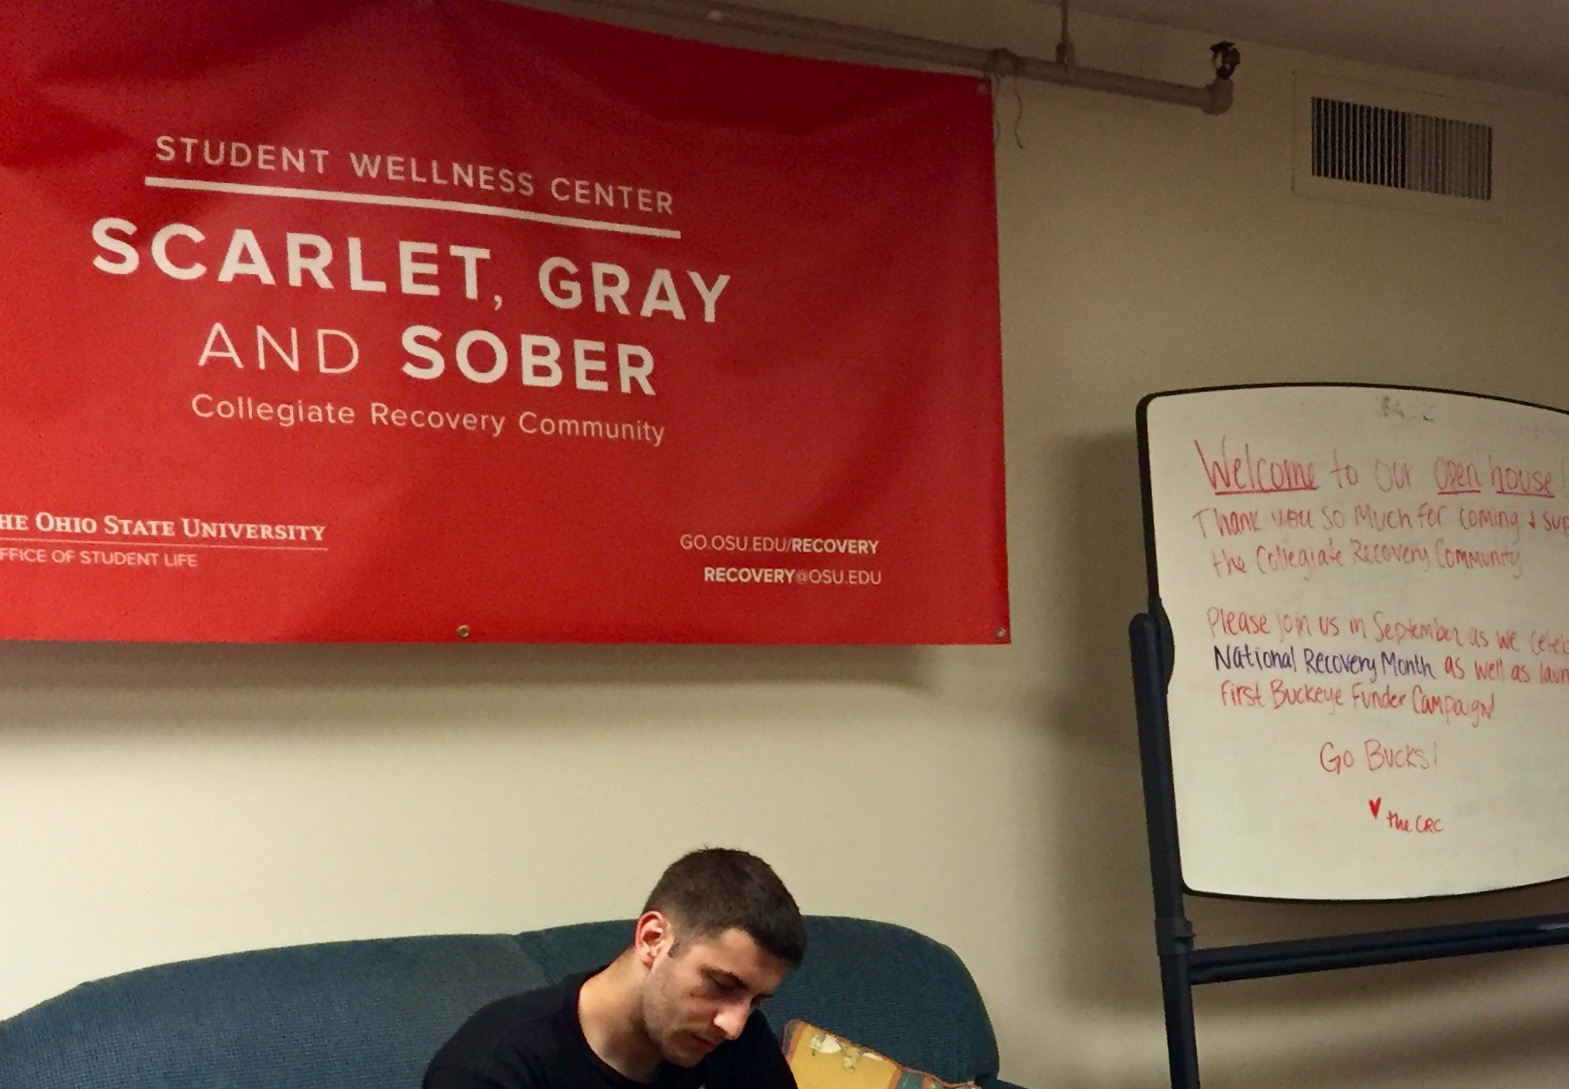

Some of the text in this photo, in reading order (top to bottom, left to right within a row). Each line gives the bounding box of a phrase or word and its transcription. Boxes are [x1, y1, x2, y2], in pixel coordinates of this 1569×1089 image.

[155, 134, 675, 215] STUDENT WELLNESS CENTER
[91, 217, 731, 323] SCARLET, GRAY
[198, 322, 657, 396] AND SOBER
[191, 393, 665, 447] Collegiate Recovery Community
[1194, 435, 1318, 492] Welcome
[1330, 448, 1359, 489] to
[0, 512, 29, 532] HE
[1193, 506, 1262, 539] Thank
[0, 547, 198, 569] FFICE OF STUDENT LIFE
[680, 533, 880, 556] GO.OSU.EDU/RECOVERY
[1212, 537, 1522, 582] the Collegiate Recovery Community
[704, 566, 882, 586] RECOVERY@OSU.EDU
[1206, 606, 1270, 639] Please
[1319, 615, 1341, 637] us
[1350, 615, 1367, 639] in
[1213, 643, 1298, 674] National
[1303, 647, 1378, 684] Recovery
[1380, 650, 1437, 681] Month
[1444, 655, 1466, 680] as
[1510, 664, 1531, 685] as
[1269, 678, 1345, 715] Buckeye
[1320, 741, 1355, 776] Go
[1386, 810, 1445, 834] the CRC
